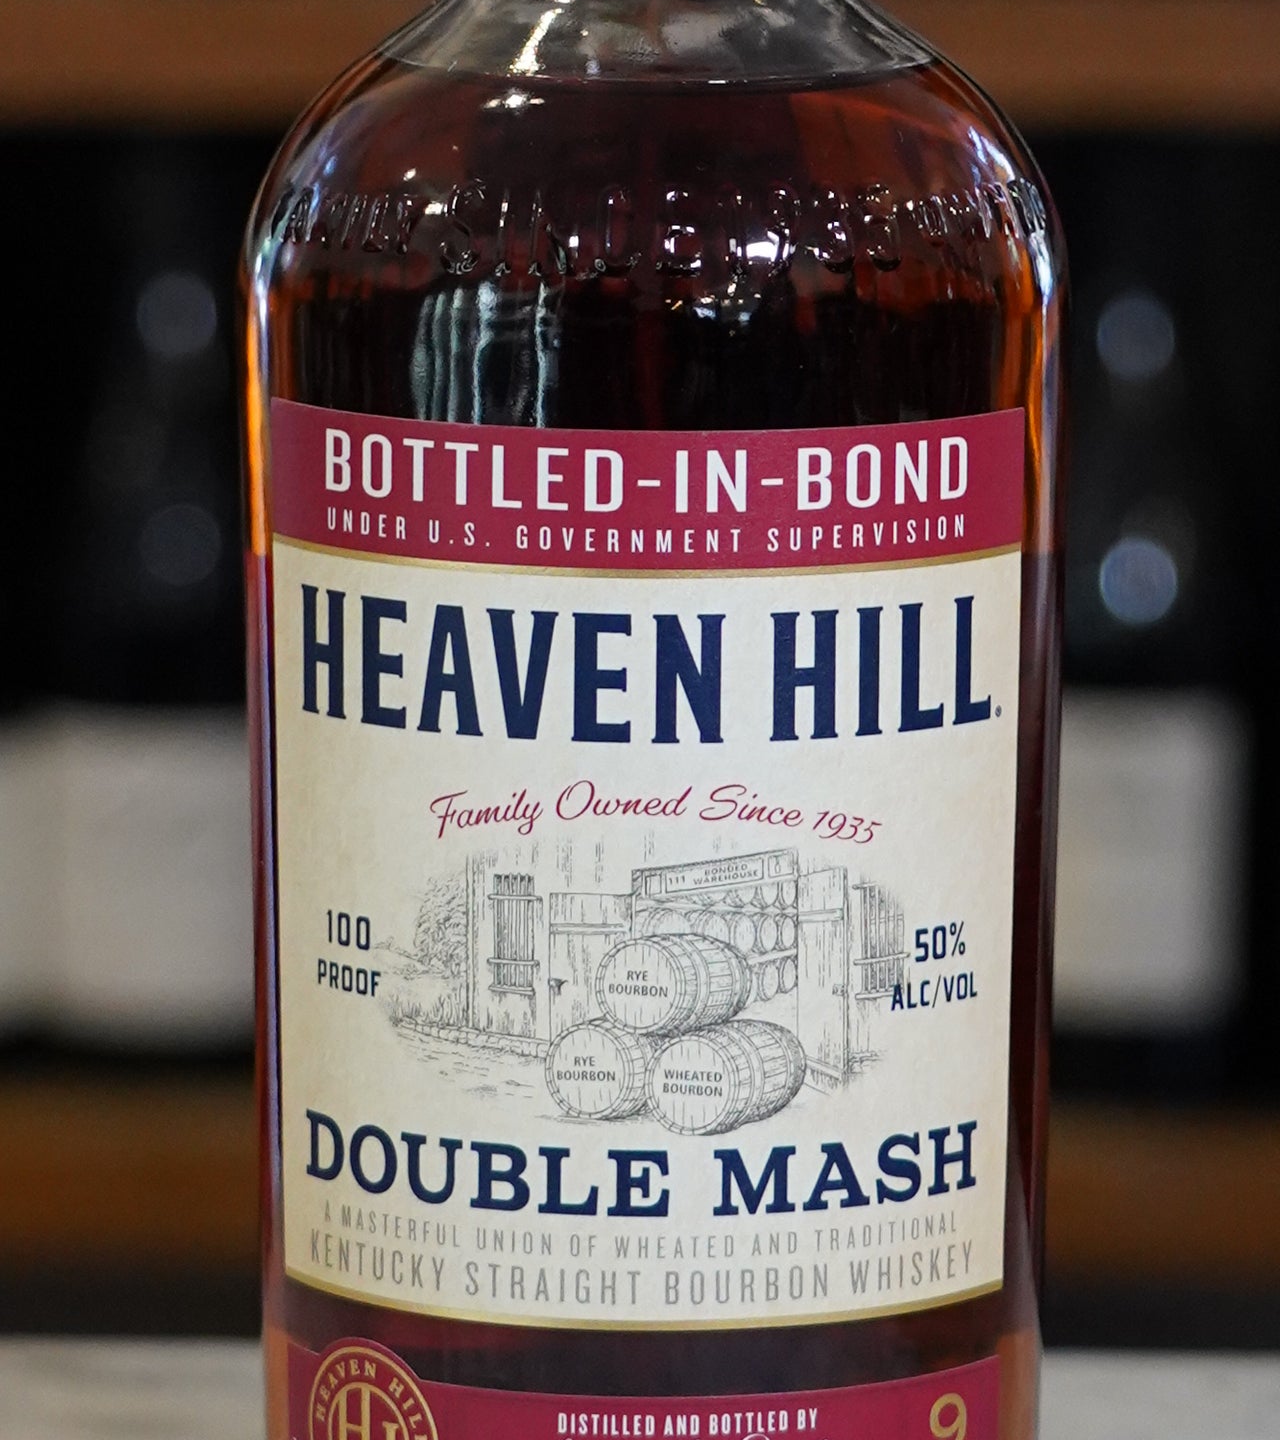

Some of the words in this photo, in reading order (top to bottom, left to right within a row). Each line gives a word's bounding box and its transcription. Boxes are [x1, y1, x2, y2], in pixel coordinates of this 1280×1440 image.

[324, 427, 969, 514] BOTTLED-IN-BOND
[326, 506, 407, 541] UNDER
[427, 519, 491, 547] U.S.
[515, 524, 741, 554] GOVERNMENT
[766, 513, 965, 552] SUPERVISION
[301, 583, 726, 745] HEAVEN
[429, 787, 544, 840] Family
[556, 779, 693, 822] Owned
[699, 783, 804, 828] Since
[811, 810, 883, 844] 1935
[326, 909, 371, 951] 100
[914, 921, 966, 963] 50%
[317, 958, 381, 997] PROOF
[608, 983, 669, 998] BOURBON
[626, 970, 649, 982] RYE
[890, 971, 978, 1011] ALC/VOL
[556, 1070, 616, 1082] BOURBON
[573, 1056, 596, 1067] RYE
[663, 1069, 723, 1083] WHEATED
[662, 1082, 723, 1097] BOURBON
[305, 1108, 672, 1217] DOUBLE
[713, 1120, 979, 1216] MASH
[324, 1199, 332, 1222] A
[340, 1205, 461, 1248] MASTERFUL
[476, 1226, 552, 1256] UNION
[569, 1234, 598, 1258] OF
[614, 1235, 735, 1259] WHEATED
[750, 1231, 798, 1257] AND
[814, 1210, 958, 1253] TRADITIONAL
[310, 1228, 445, 1292] KENTUCKY
[465, 1260, 641, 1307] STRAIGHT
[663, 1263, 829, 1306] BOURBON
[849, 1239, 973, 1295] WHISKEY
[315, 1358, 377, 1422] HEAVEN
[557, 1412, 656, 1437] DISTILLED
[663, 1414, 700, 1436] AND
[708, 1410, 789, 1435] BOTTLED
[797, 1408, 819, 1429] BY
